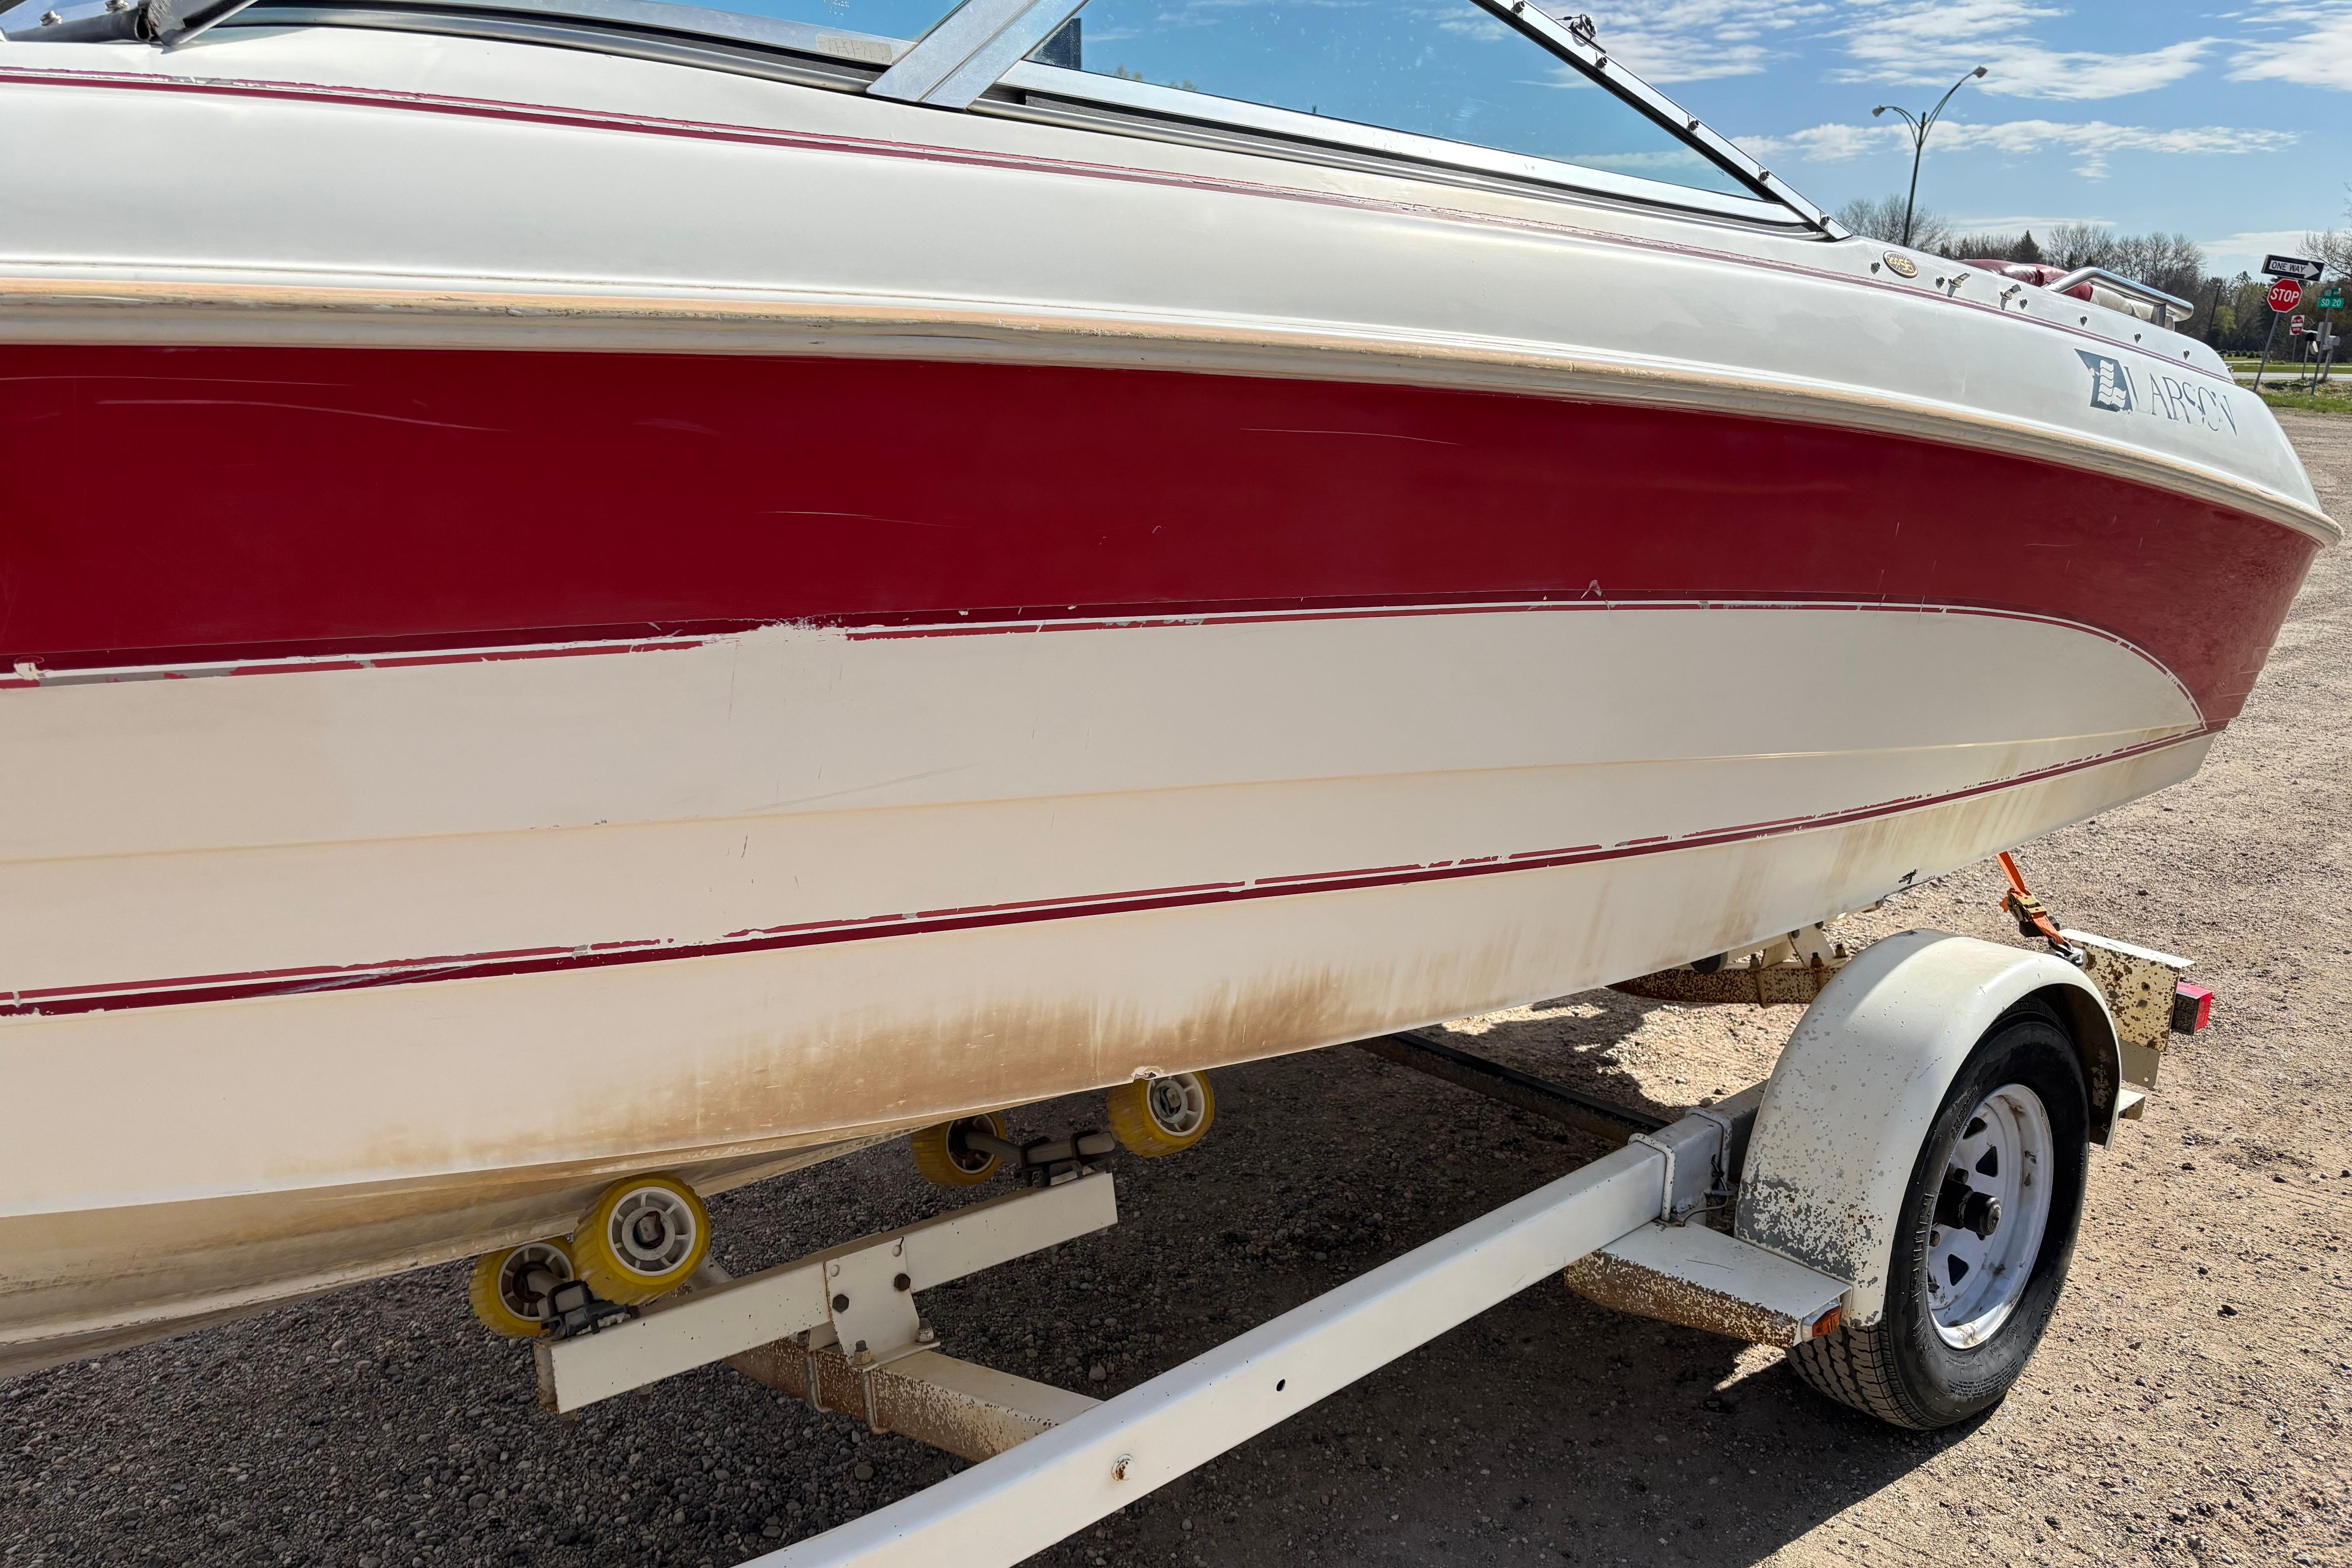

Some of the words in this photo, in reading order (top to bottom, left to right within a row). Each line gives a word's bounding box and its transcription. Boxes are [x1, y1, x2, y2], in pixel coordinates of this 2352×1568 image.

[2272, 261, 2287, 271] ONE
[2289, 264, 2306, 273] WAY
[2270, 288, 2299, 303] STOP
